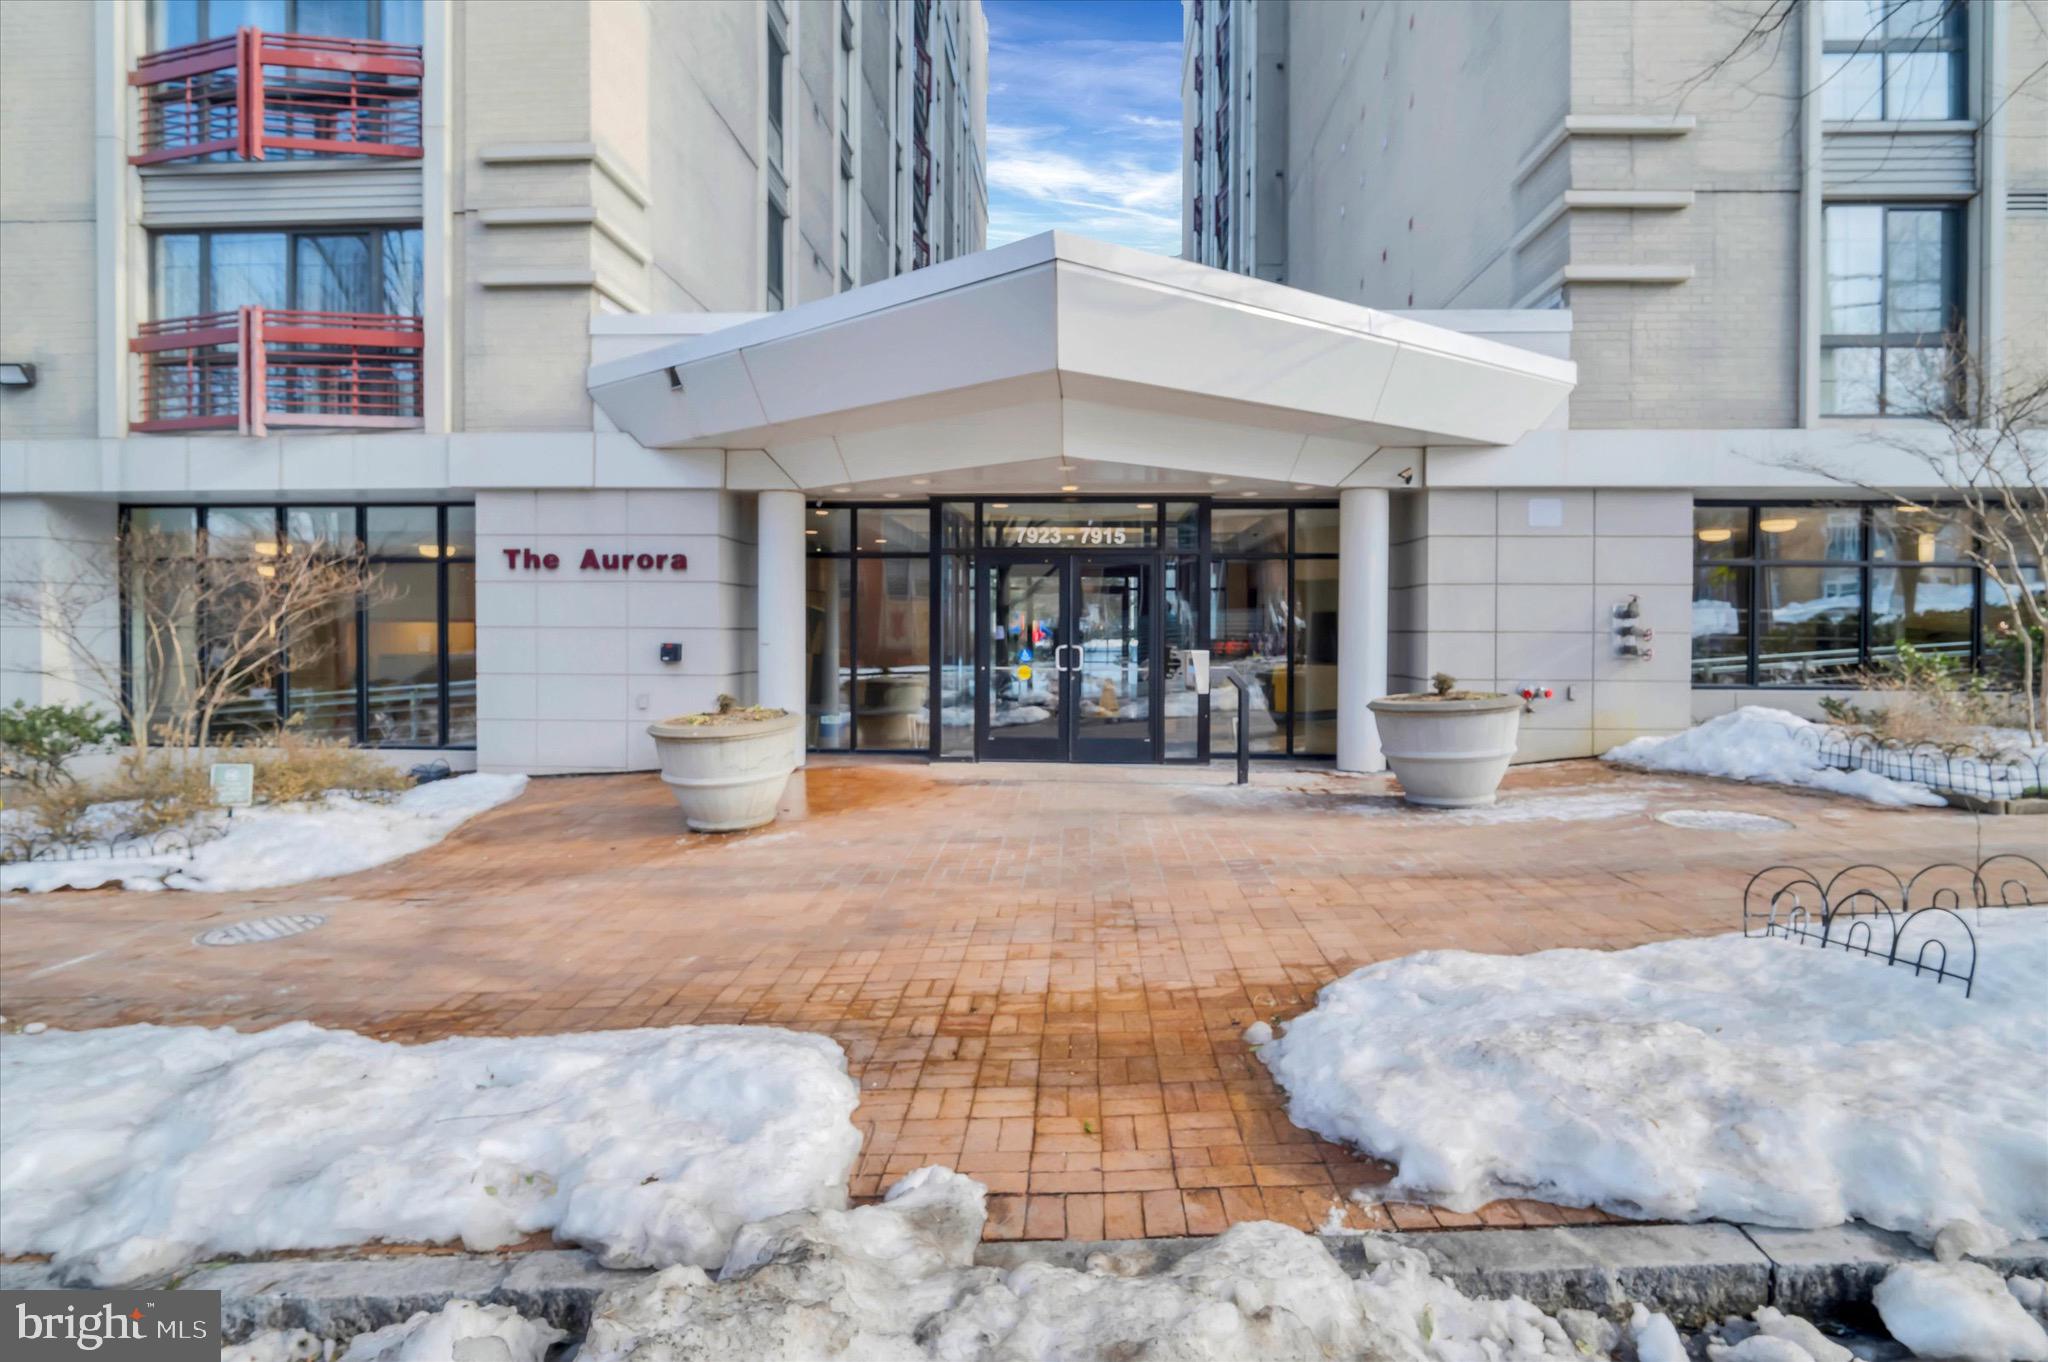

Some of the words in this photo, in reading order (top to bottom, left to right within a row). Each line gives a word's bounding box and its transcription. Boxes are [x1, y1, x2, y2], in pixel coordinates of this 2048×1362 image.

[1016, 526, 1061, 544] 7923
[1081, 526, 1126, 544] 7915
[503, 548, 560, 570] The
[579, 548, 688, 570] Aurora
